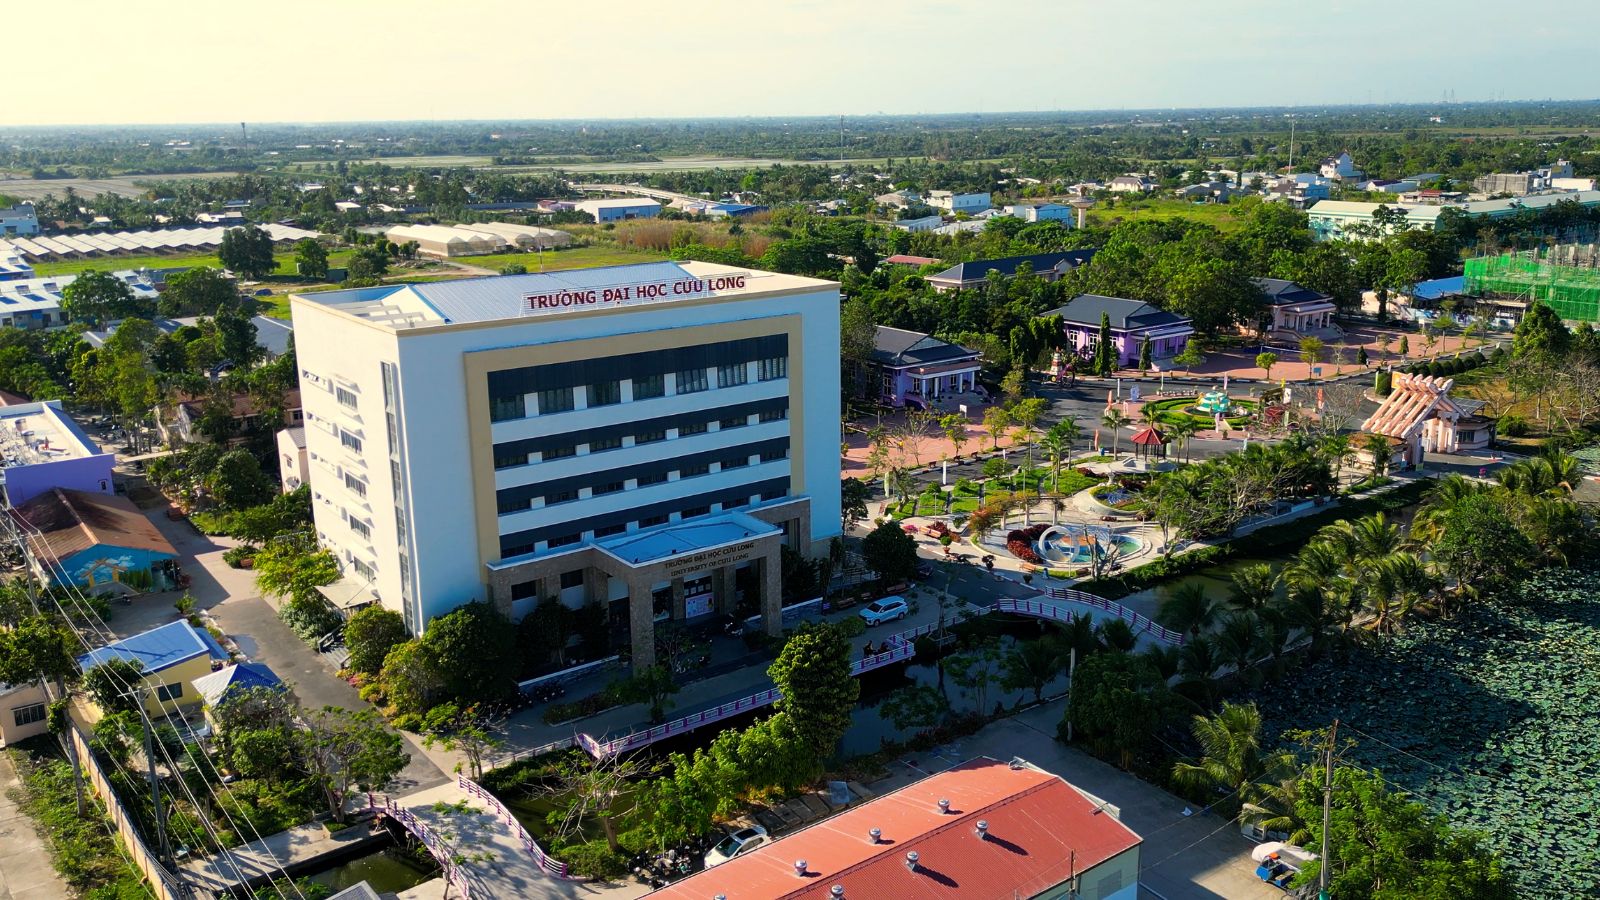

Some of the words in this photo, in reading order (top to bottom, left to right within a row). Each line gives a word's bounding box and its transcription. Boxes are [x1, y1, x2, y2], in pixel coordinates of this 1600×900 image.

[527, 289, 596, 310] TRƯỜNG
[602, 288, 630, 304] ĐẠI
[636, 284, 668, 300] HỌC
[708, 276, 745, 291] LONG
[708, 550, 722, 558] HỌC
[738, 542, 754, 551] LONG
[670, 562, 708, 576] UNIVERSITY
[732, 552, 749, 562] LONG
